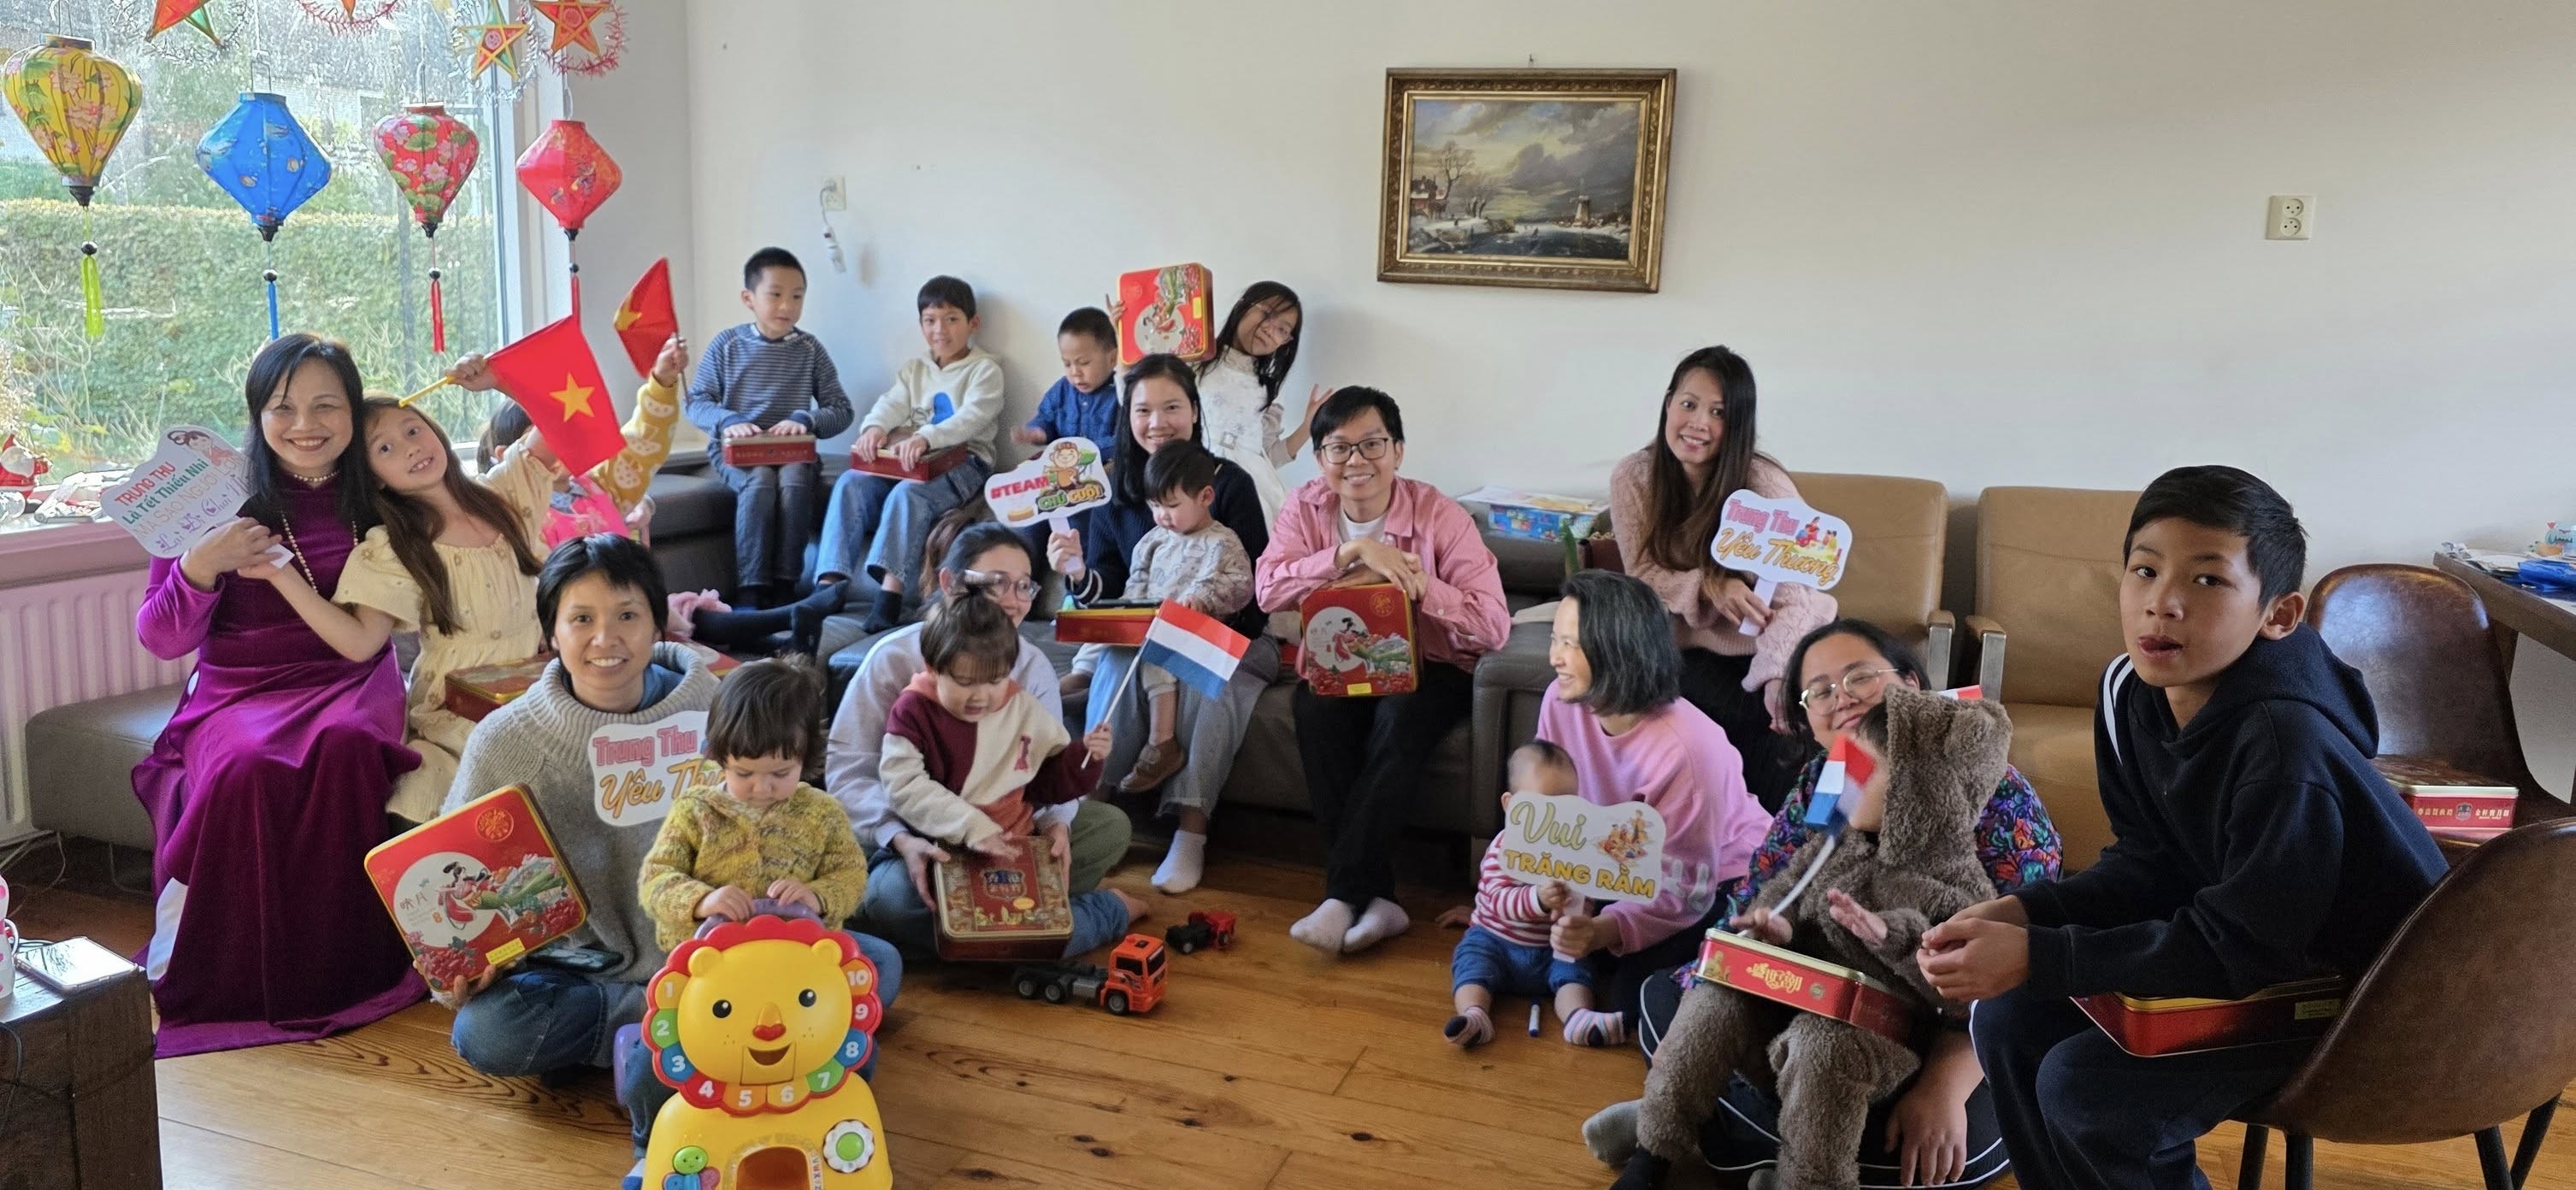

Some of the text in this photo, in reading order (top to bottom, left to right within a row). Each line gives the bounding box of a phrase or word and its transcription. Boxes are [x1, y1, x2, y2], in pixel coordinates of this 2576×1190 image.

[150, 462, 175, 480] THU
[121, 458, 209, 524] Là Tết Thiếu Nhi
[990, 475, 1050, 499] #TEAM
[1725, 498, 1800, 536] Trung Thu
[1717, 527, 1761, 560] Yêu
[592, 725, 698, 767] Trung Thu
[599, 768, 665, 819] Yêu
[1510, 801, 1588, 851] Vui
[1504, 849, 1656, 898] TRĂNG RẰM
[846, 969, 869, 987] 10
[664, 981, 674, 999] 1
[854, 1003, 869, 1020] 9
[656, 1019, 669, 1036] 2
[845, 1040, 859, 1057] 8
[671, 1055, 686, 1073] 3
[816, 1071, 831, 1088] 7
[698, 1080, 715, 1098] 4
[738, 1089, 752, 1107] 5
[780, 1085, 794, 1103] 6
